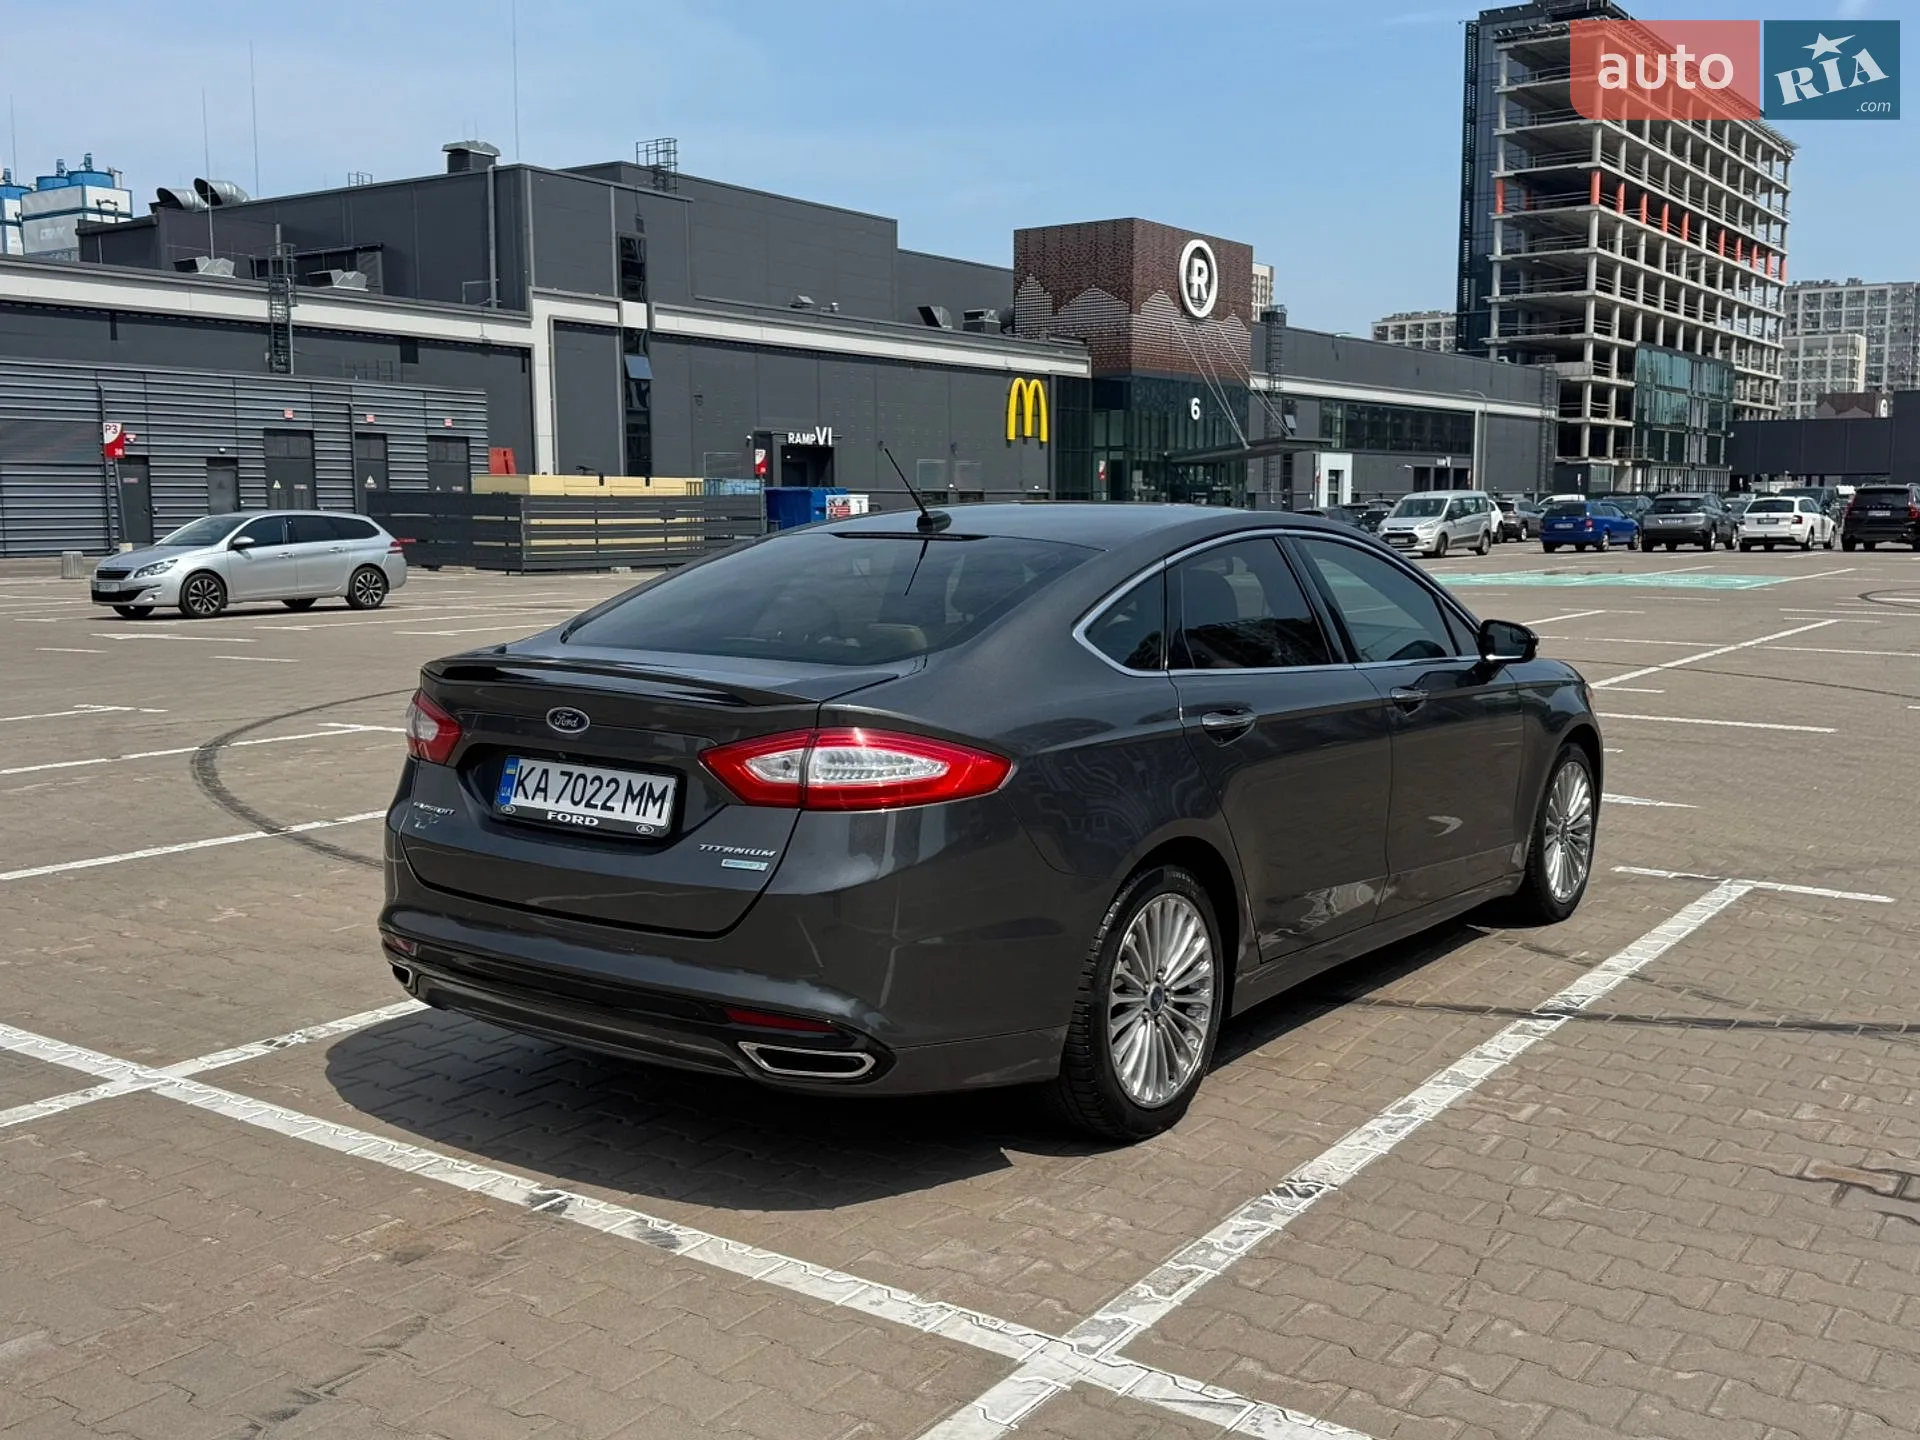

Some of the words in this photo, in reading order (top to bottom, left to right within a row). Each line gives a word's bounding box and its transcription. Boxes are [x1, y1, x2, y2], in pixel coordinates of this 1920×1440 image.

[1190, 397, 1200, 420] 6
[105, 424, 118, 435] P3
[788, 432, 816, 445] RAMP
[815, 426, 832, 446] VI
[554, 712, 579, 727] Ford
[514, 765, 549, 803] KA
[555, 770, 620, 812] 7022
[621, 779, 669, 819] MM
[547, 811, 599, 826] FORD
[699, 844, 777, 857] TITANIUM
